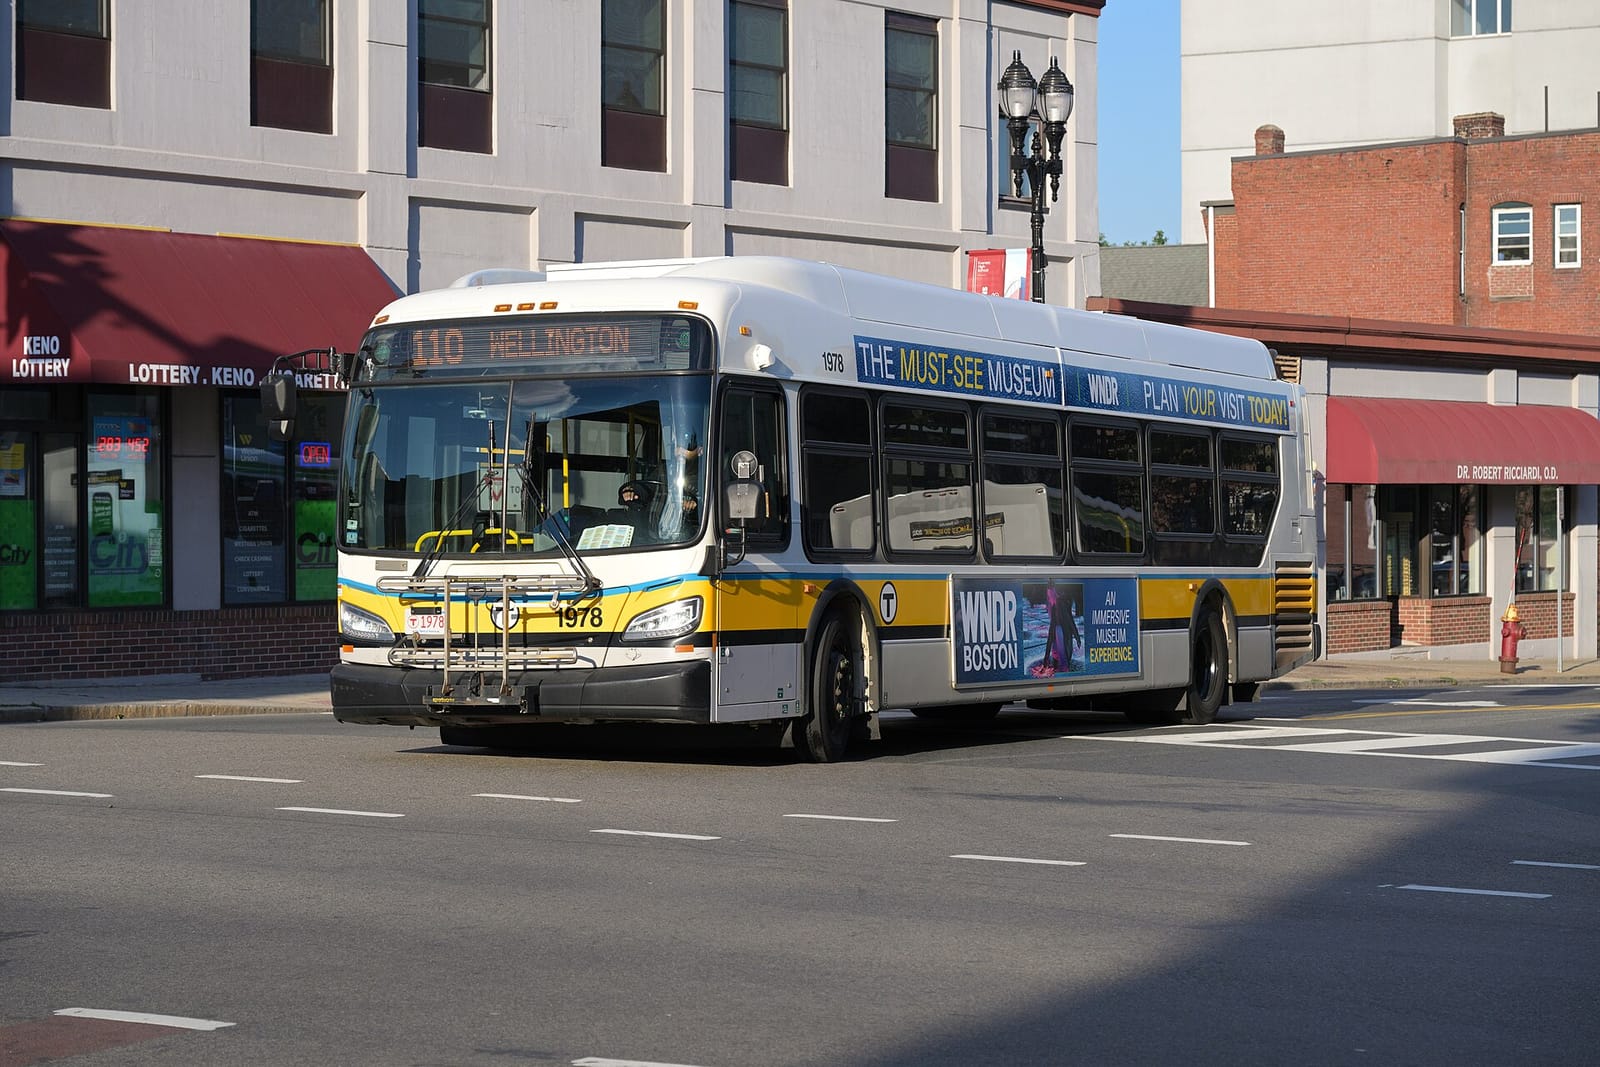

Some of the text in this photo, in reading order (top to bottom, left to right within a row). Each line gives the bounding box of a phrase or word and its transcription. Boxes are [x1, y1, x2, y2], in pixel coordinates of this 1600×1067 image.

[23, 335, 60, 355] KENO
[411, 326, 630, 366] 110 WELLINGTON
[12, 358, 71, 377] LOTTERY
[822, 351, 844, 373] 1978
[858, 342, 1056, 399] THE MUST-SEE MUSEUM
[211, 367, 255, 386] KENO
[1087, 373, 1119, 406] WNDR
[1143, 380, 1288, 426] PLAN YOUR VISIT TODAY!
[303, 446, 329, 463] OPEN
[1457, 465, 1559, 481] DR. ROBERT RICCIARDI, O.D.
[0, 544, 31, 566] City
[90, 532, 150, 574] City
[297, 532, 337, 563] Cit
[1105, 591, 1117, 606] AN
[420, 615, 444, 629] 1978
[555, 606, 603, 628] 1978
[959, 590, 1018, 643] WNDR
[1091, 609, 1130, 625] IMMERSIVE
[1096, 628, 1126, 644] MUSEUM
[963, 643, 1018, 672] BOSTON
[1089, 646, 1134, 663] EXPERIENCE.
